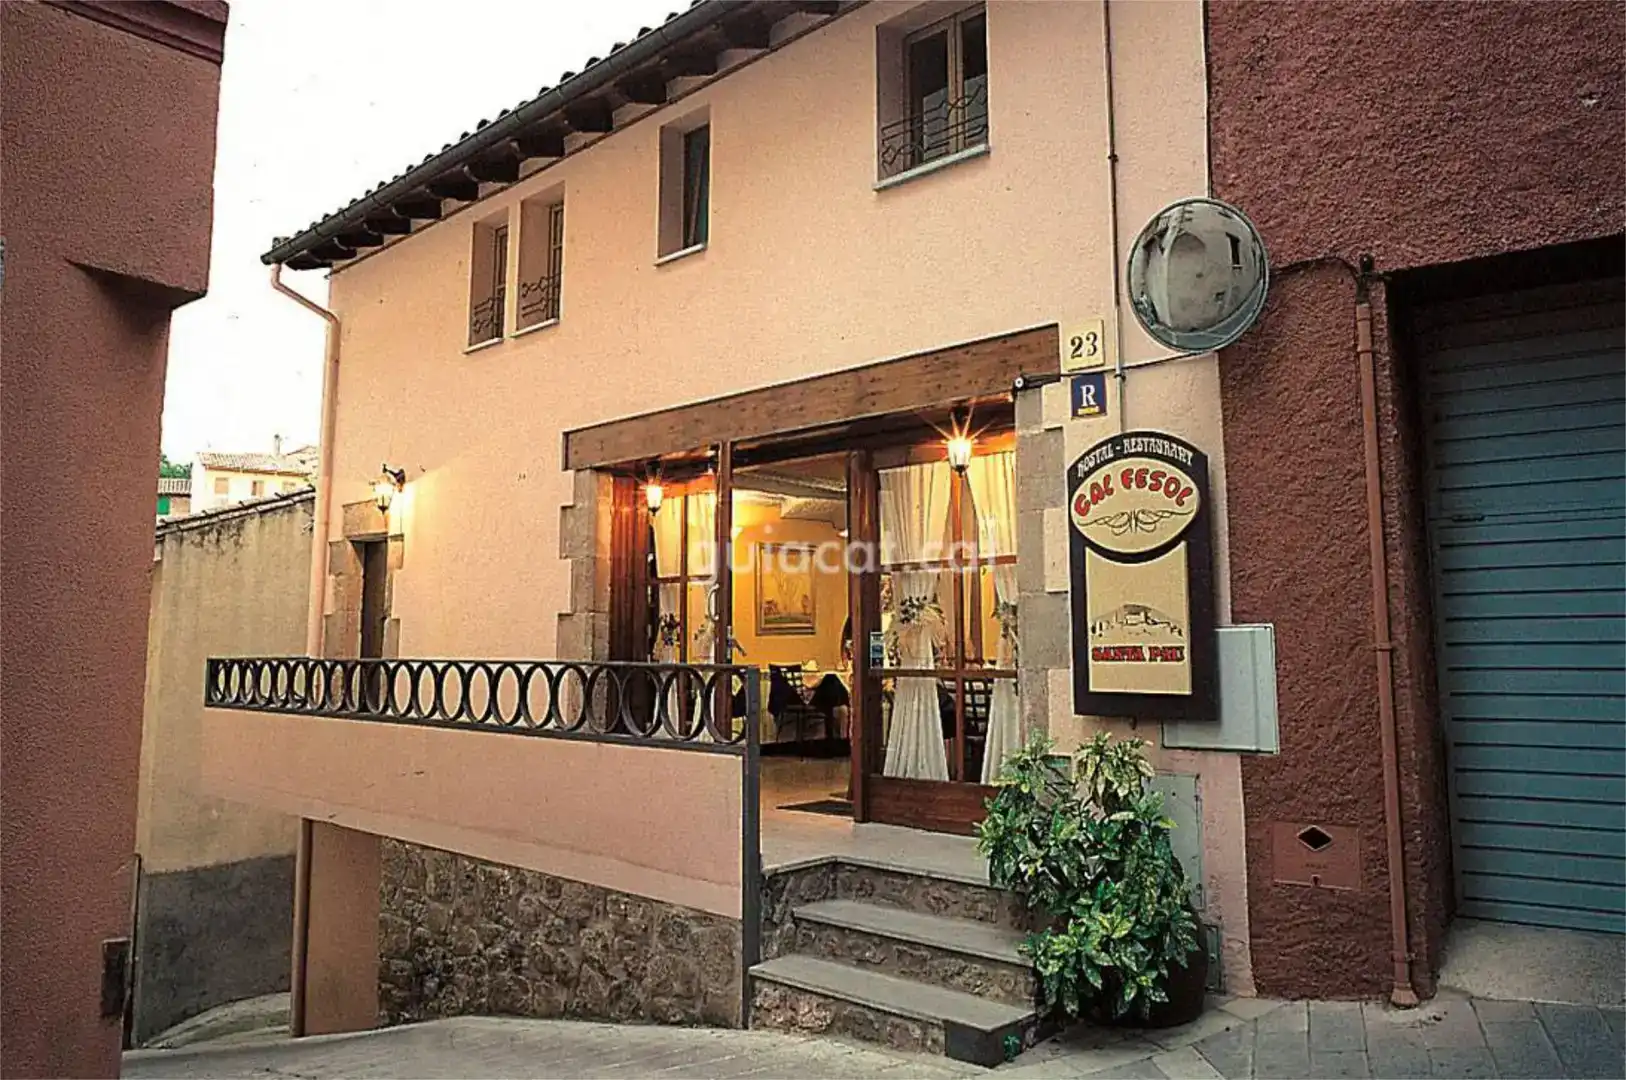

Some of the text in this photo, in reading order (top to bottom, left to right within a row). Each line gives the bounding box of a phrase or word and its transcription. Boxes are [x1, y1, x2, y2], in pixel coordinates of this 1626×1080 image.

[1070, 331, 1098, 359] 23
[1080, 384, 1097, 407] R
[1074, 468, 1194, 517] CAL FESOL
